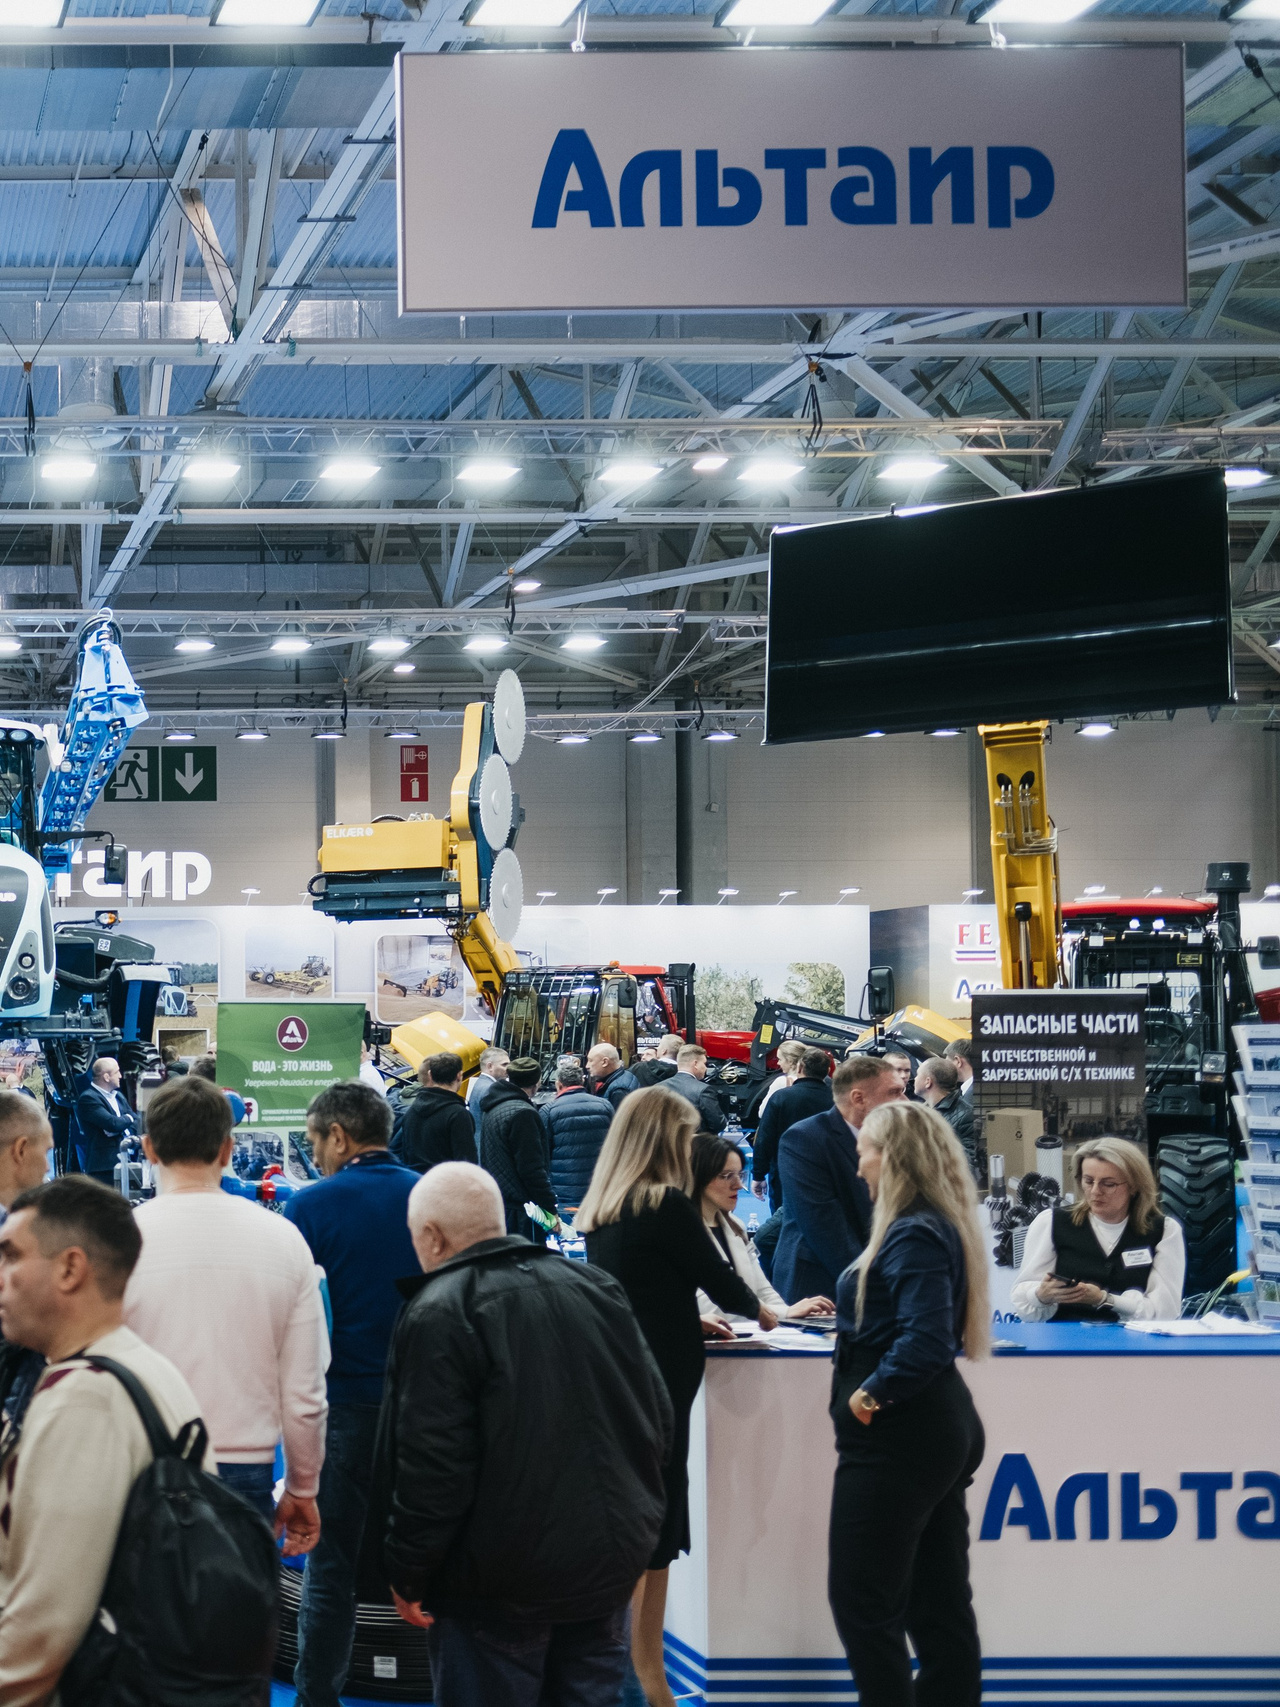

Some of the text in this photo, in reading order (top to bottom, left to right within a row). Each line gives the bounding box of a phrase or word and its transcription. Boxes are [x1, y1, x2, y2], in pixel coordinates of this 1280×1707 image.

[531, 128, 1055, 228] Альтаир
[326, 827, 364, 839] ELKÆR
[980, 1014, 1139, 1034] ЗАПАСНЫЕ ЧАСТИ
[981, 1046, 1096, 1063] К ОТЕЧЕСТВЕННОЙ и
[252, 1060, 276, 1073] ВОДА
[282, 1061, 299, 1072] ЭТО
[299, 1060, 333, 1072] ЖИЗНЬ
[982, 1065, 1135, 1082] ЗАРУБЕЖНОЙ С/Х ТЕХНИКЕ
[244, 1077, 341, 1088] Уверенно двигайся вперё
[978, 1453, 1280, 1541] Альта
